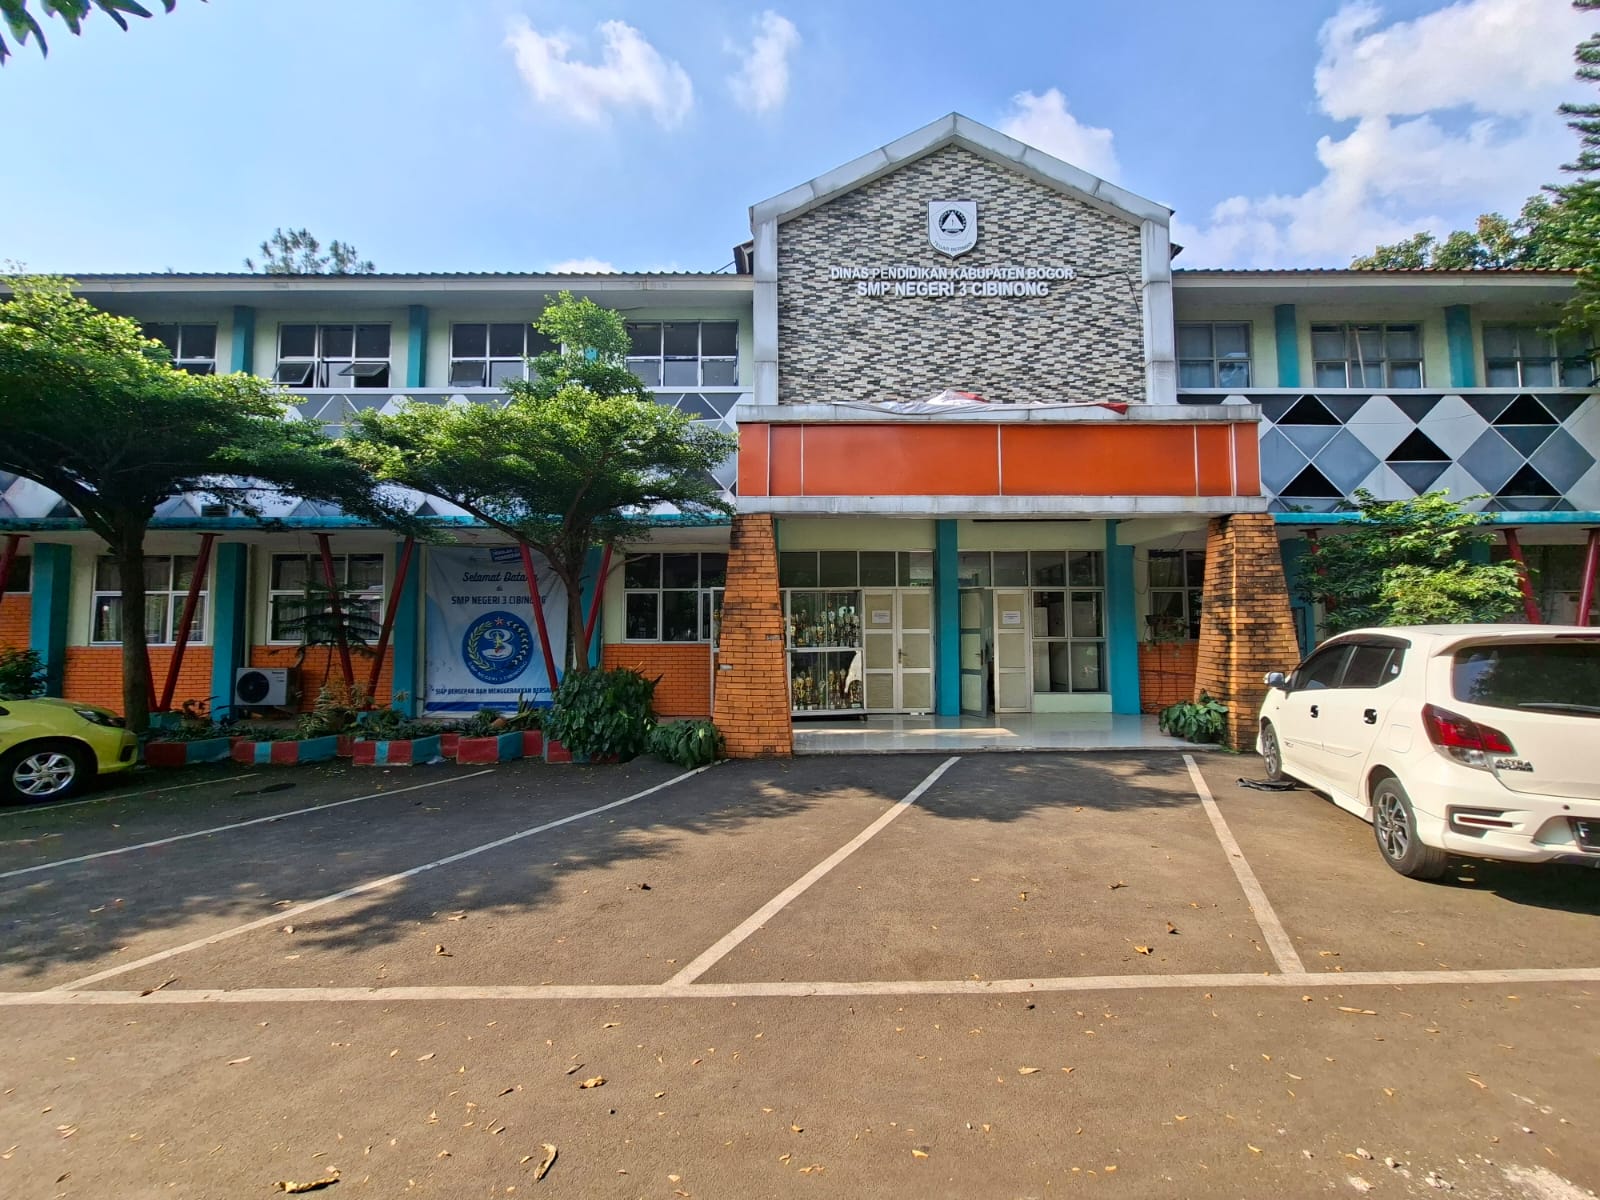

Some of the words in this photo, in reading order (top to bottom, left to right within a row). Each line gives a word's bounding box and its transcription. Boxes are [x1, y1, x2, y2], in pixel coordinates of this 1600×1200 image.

[831, 267, 869, 280] DINAS
[872, 267, 946, 280] PENDIDIKAN
[950, 267, 1025, 280] KABUPATEN
[1027, 267, 1074, 280] BOGOR
[857, 282, 890, 297] SMP
[895, 282, 954, 297] NEGERI
[959, 282, 966, 297] 3
[972, 282, 1049, 297] CIBINONG
[462, 571, 501, 582] Selamat
[451, 595, 470, 605] SMP
[472, 595, 500, 605] NEGERI
[501, 595, 507, 605] 3
[1495, 758, 1533, 768] ASTRA
